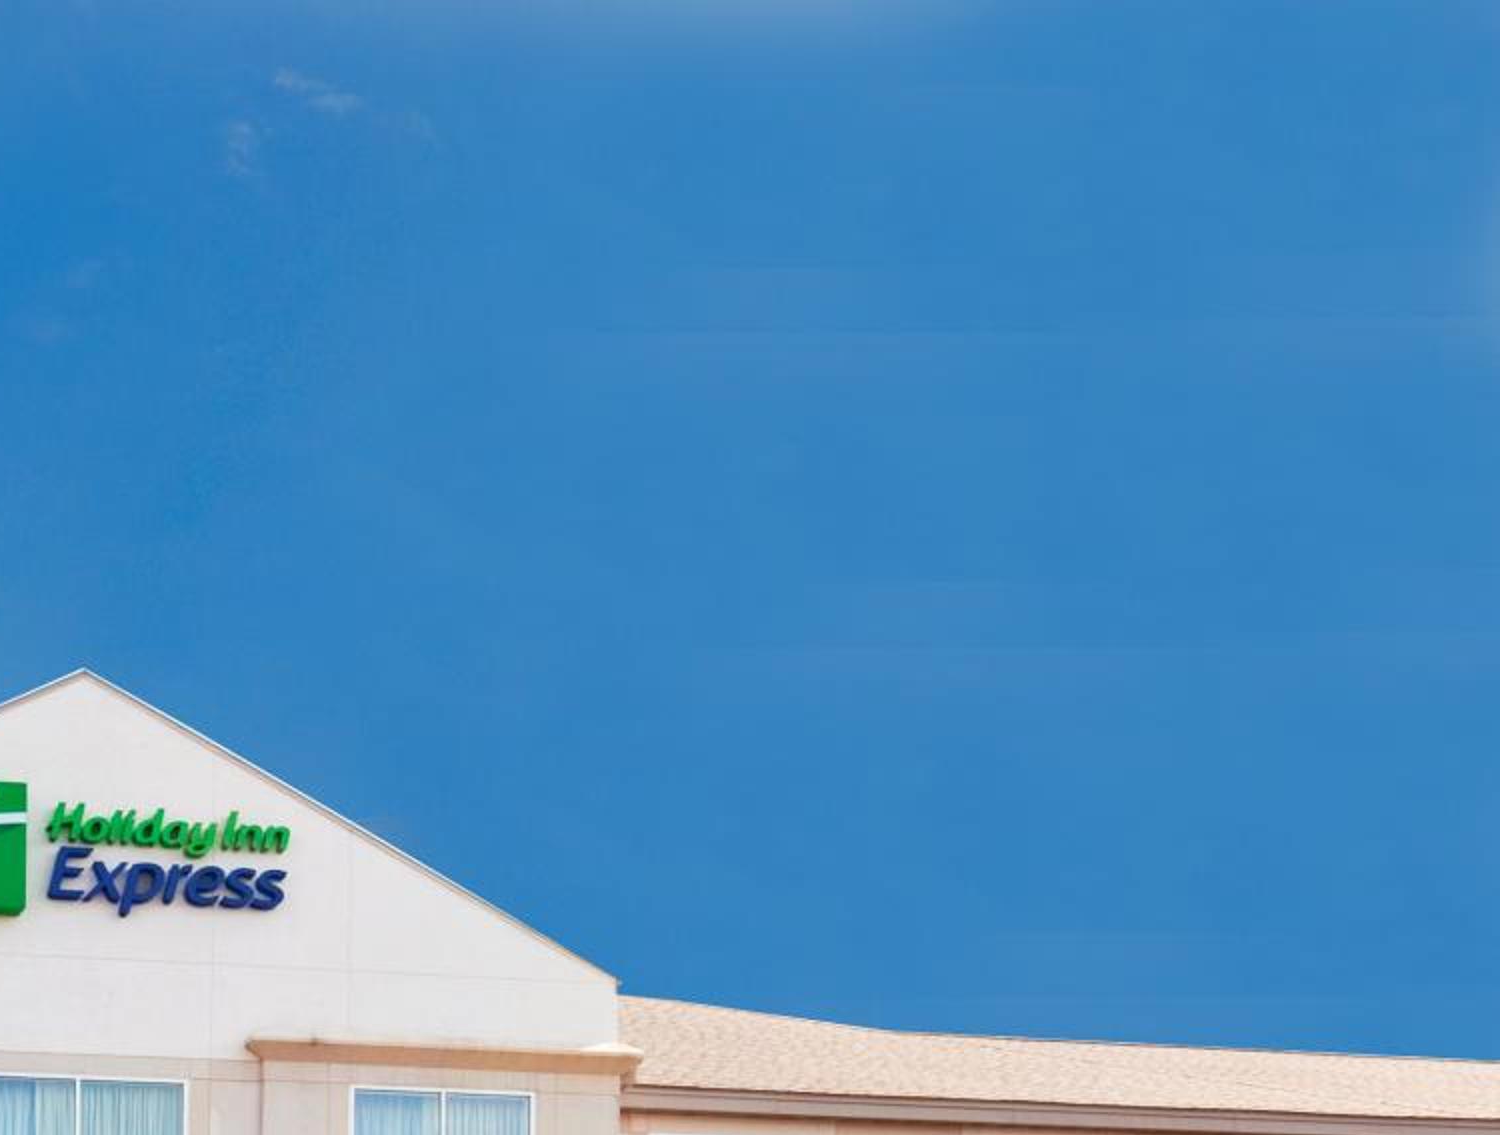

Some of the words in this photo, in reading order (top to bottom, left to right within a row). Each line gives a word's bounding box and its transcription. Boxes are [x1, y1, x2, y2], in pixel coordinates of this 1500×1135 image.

[46, 801, 218, 858] Holiday
[221, 811, 290, 854] Inn
[47, 846, 287, 917] Express
